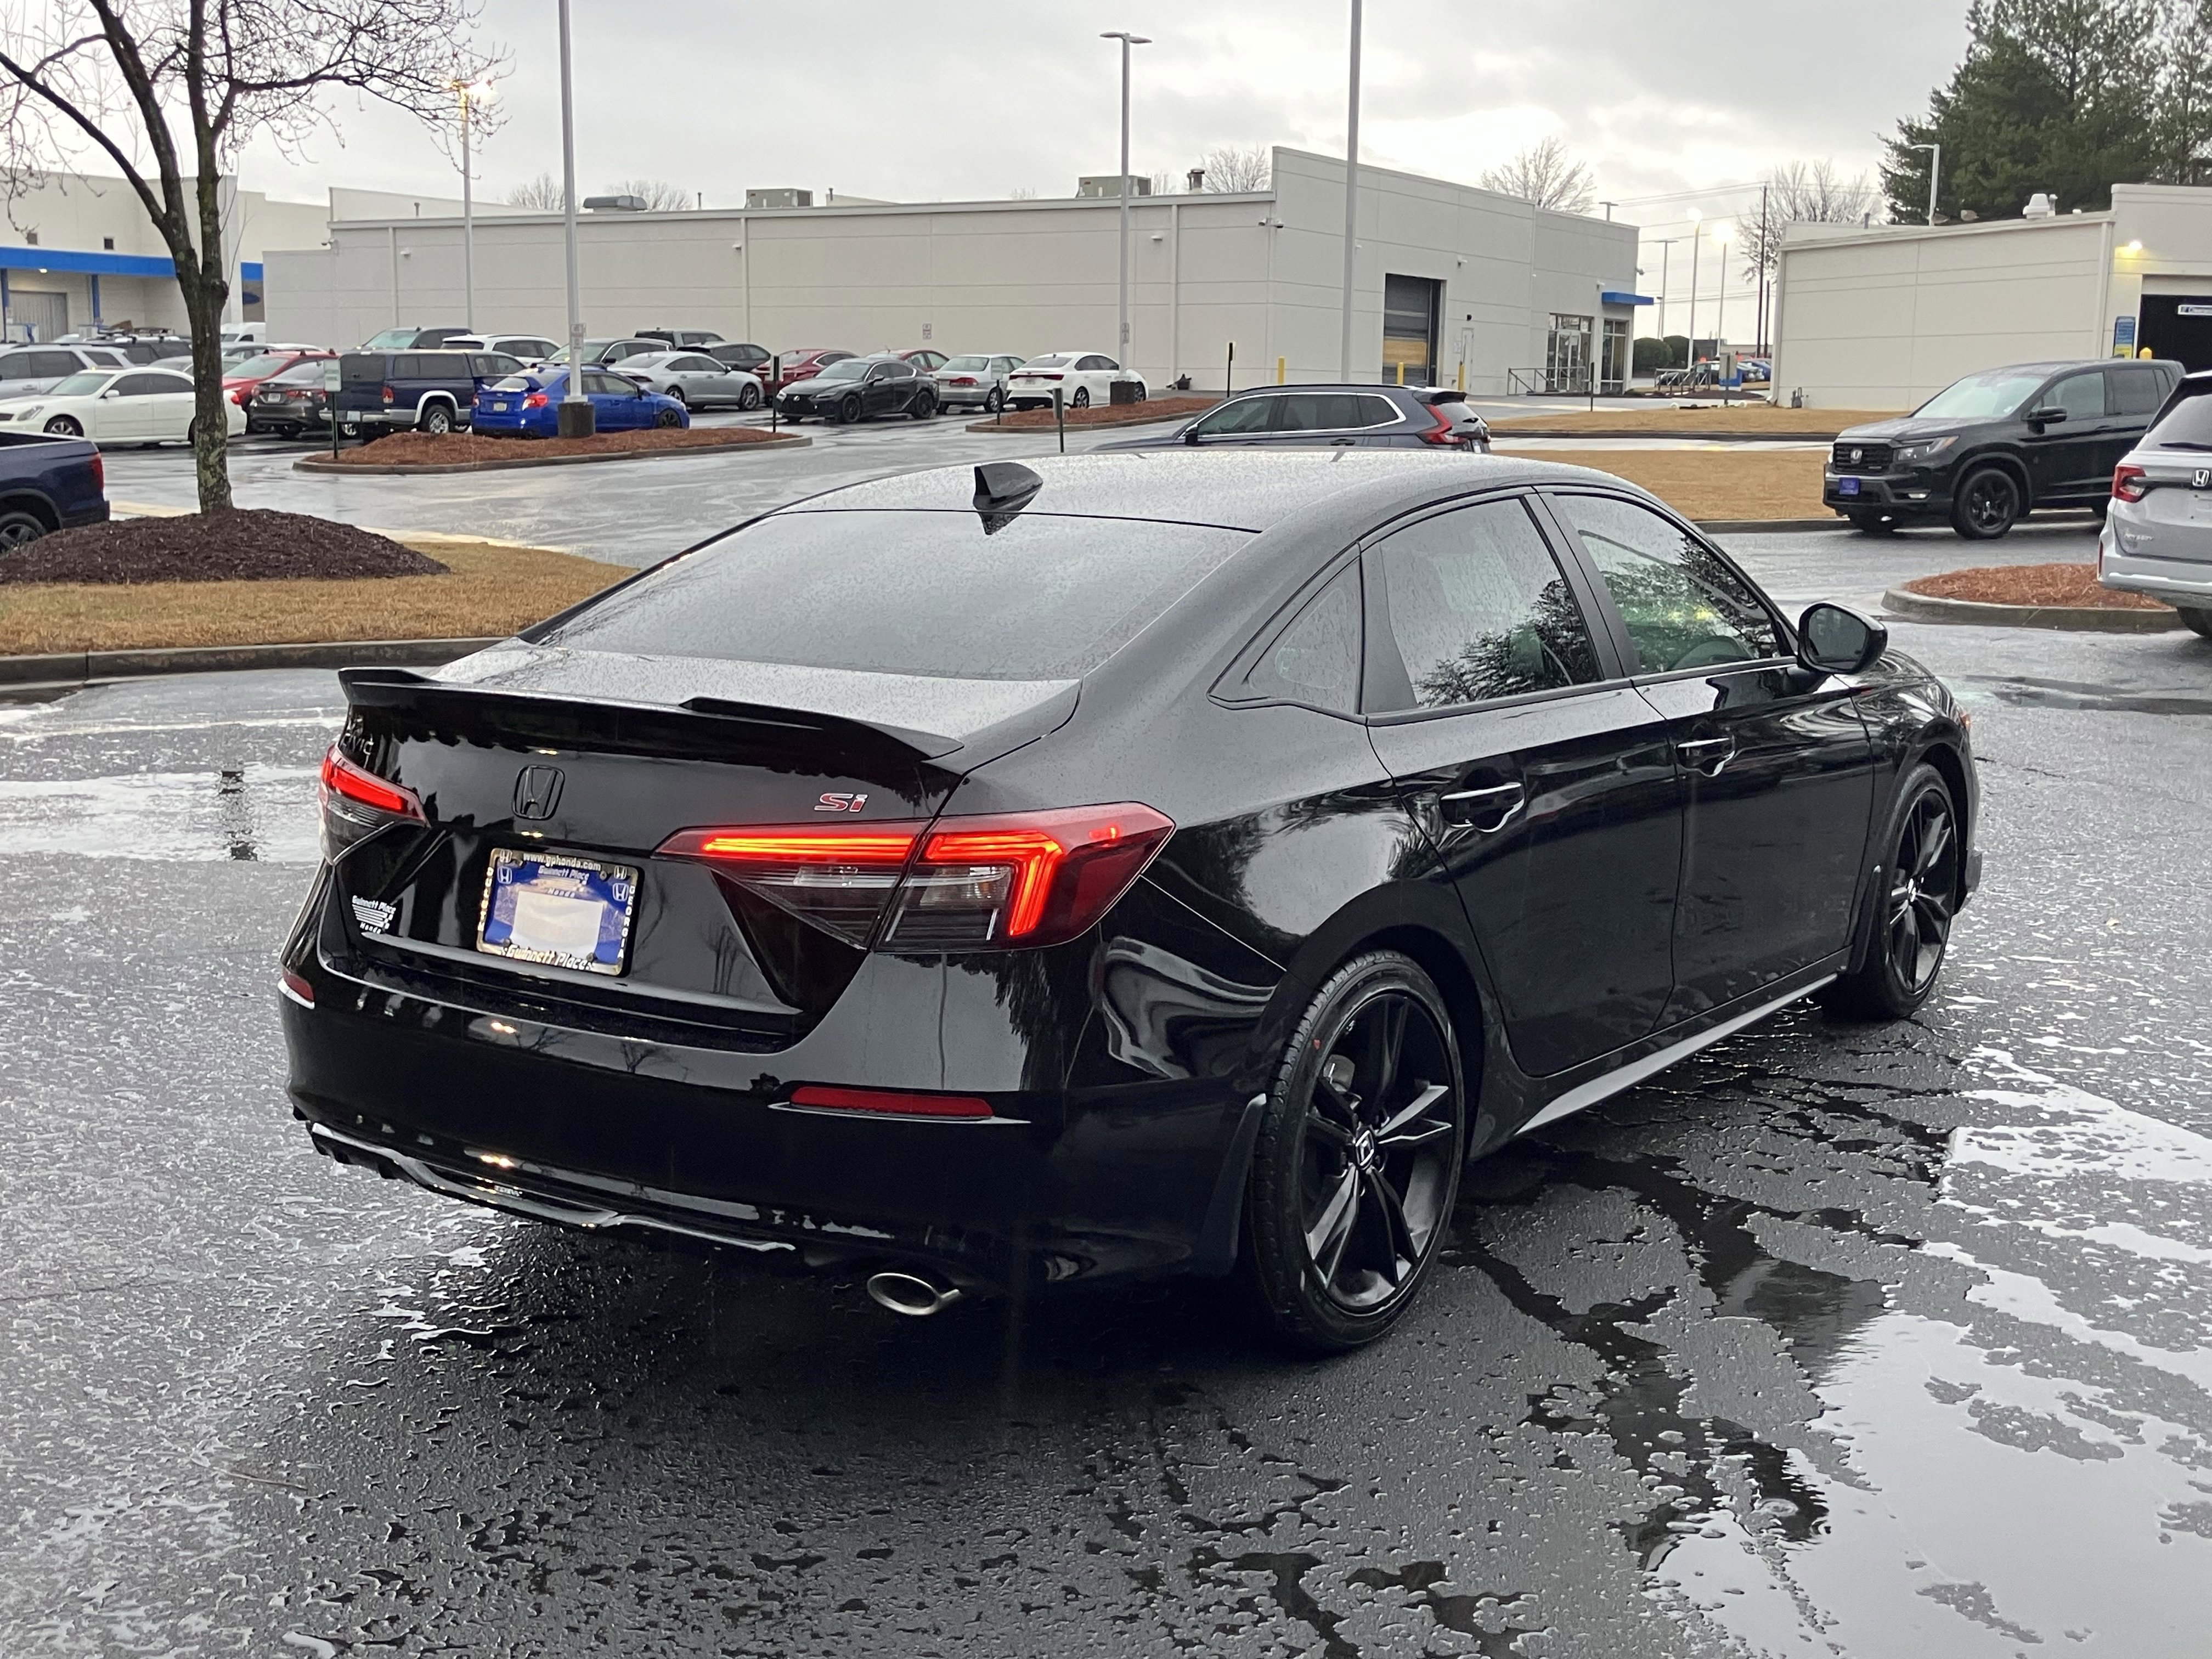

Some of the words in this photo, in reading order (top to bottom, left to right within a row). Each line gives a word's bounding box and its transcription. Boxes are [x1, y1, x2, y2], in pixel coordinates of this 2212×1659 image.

[814, 793, 868, 812] Si
[523, 853, 601, 871] www.gphonda.com
[477, 867, 494, 932] DULUTH
[548, 888, 575, 898] Honda
[617, 885, 635, 958] GEORGIA
[506, 944, 556, 964] Gwinnett
[555, 952, 589, 970] Place
